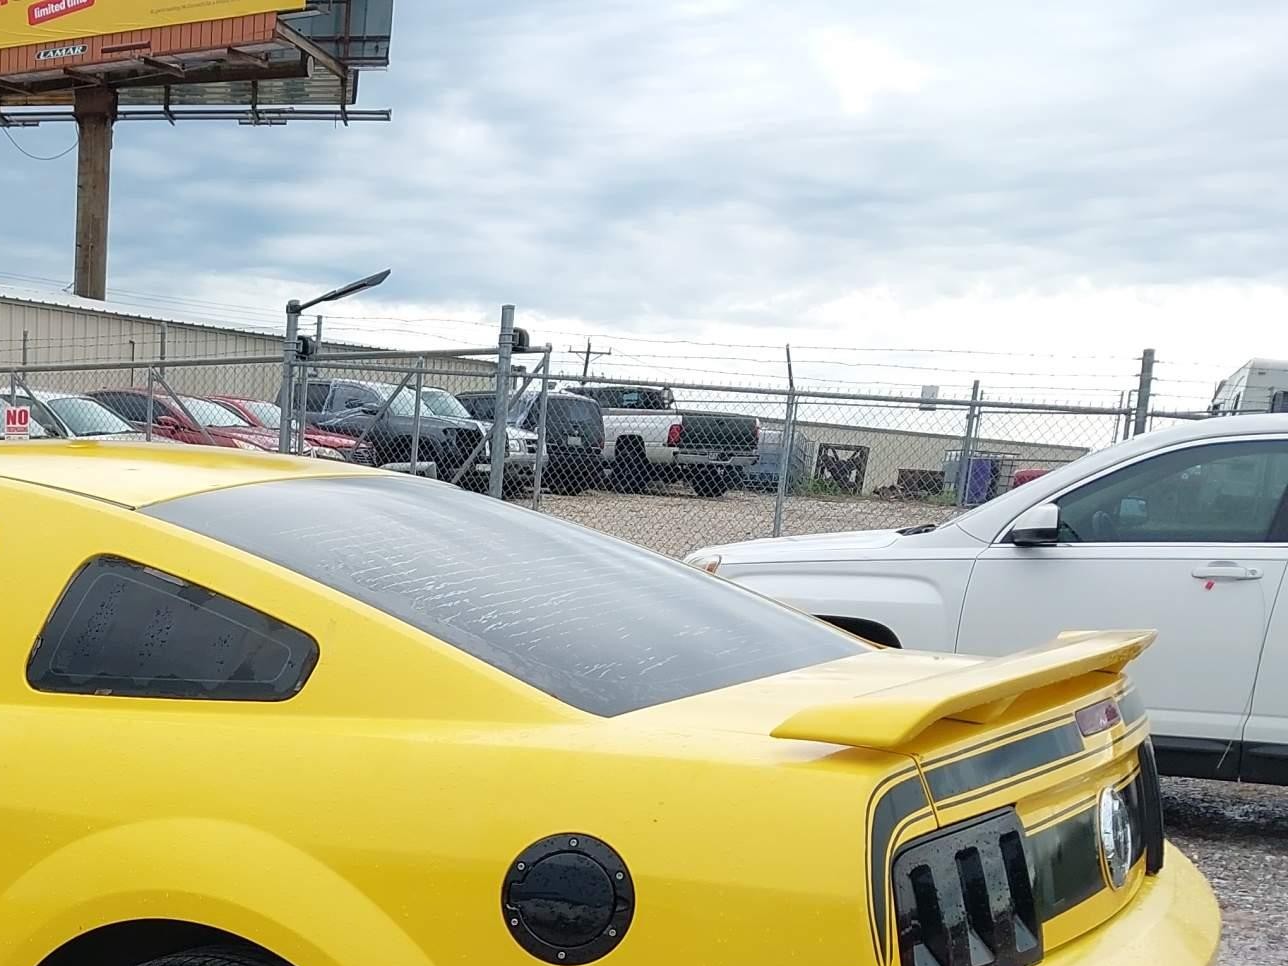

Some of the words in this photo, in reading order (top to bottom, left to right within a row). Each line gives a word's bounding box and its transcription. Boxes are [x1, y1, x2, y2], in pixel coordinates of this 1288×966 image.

[34, 0, 65, 19] limited
[39, 46, 82, 59] LAMAR
[6, 409, 29, 425] NO
